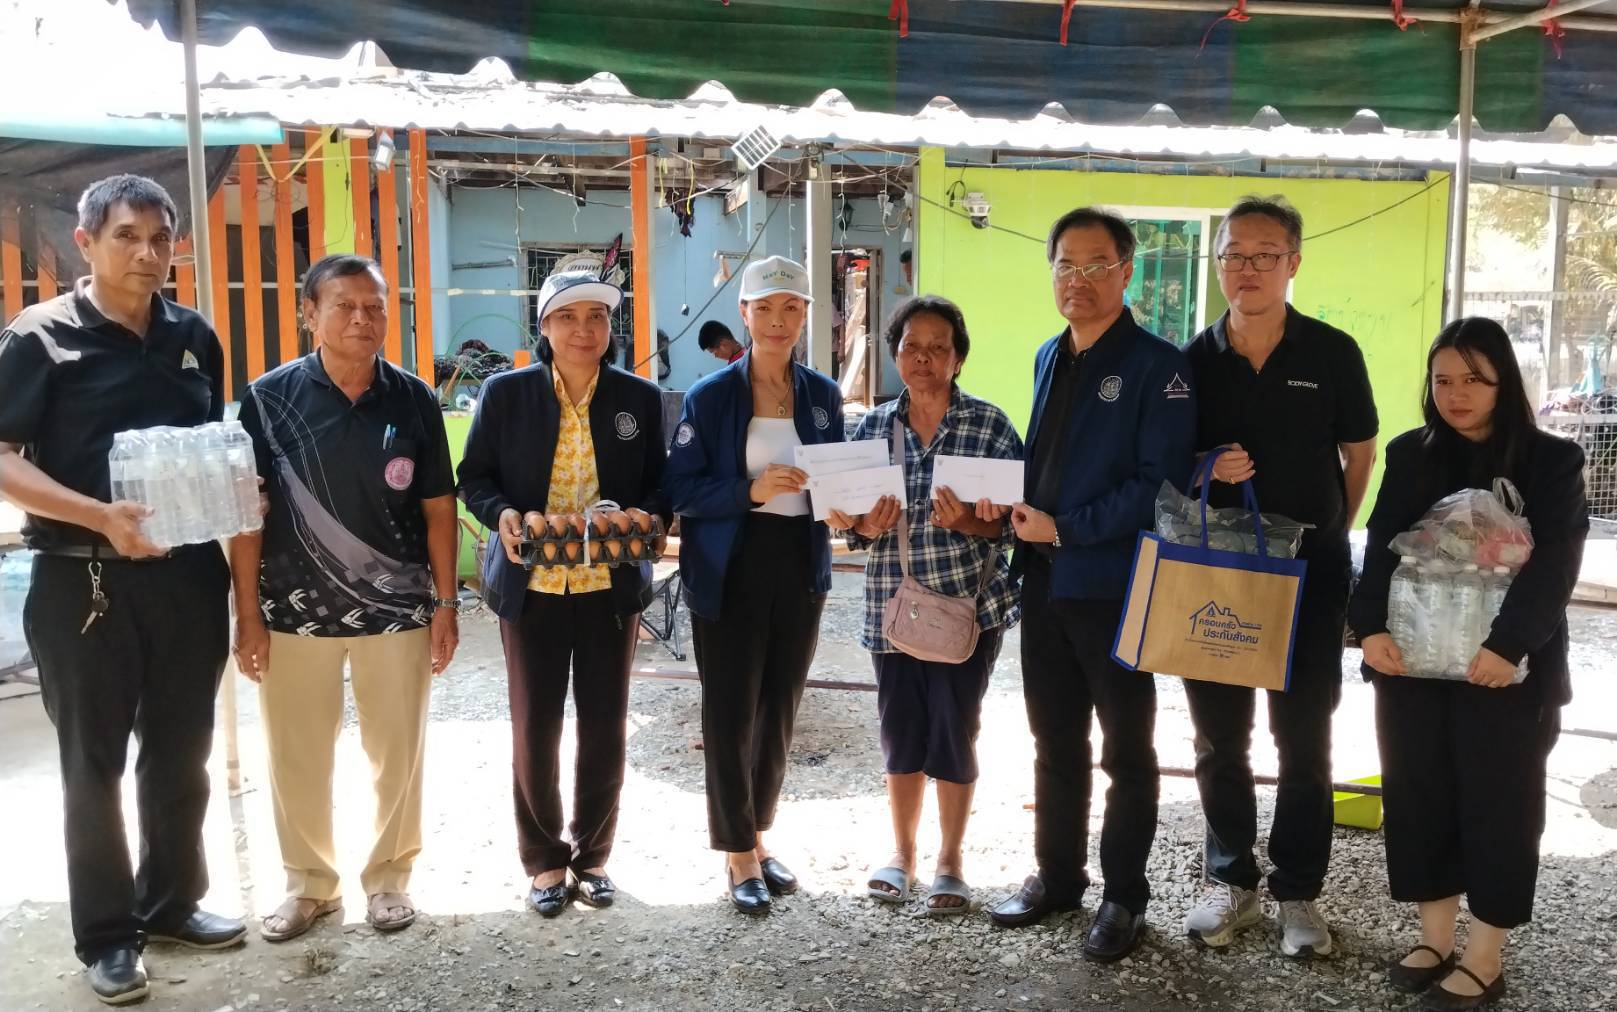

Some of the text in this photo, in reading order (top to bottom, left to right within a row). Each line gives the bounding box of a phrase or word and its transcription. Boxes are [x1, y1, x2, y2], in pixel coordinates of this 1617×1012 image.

[1199, 618, 1236, 630] ครอบครัว
[1203, 628, 1259, 644] ประกันสังคม
